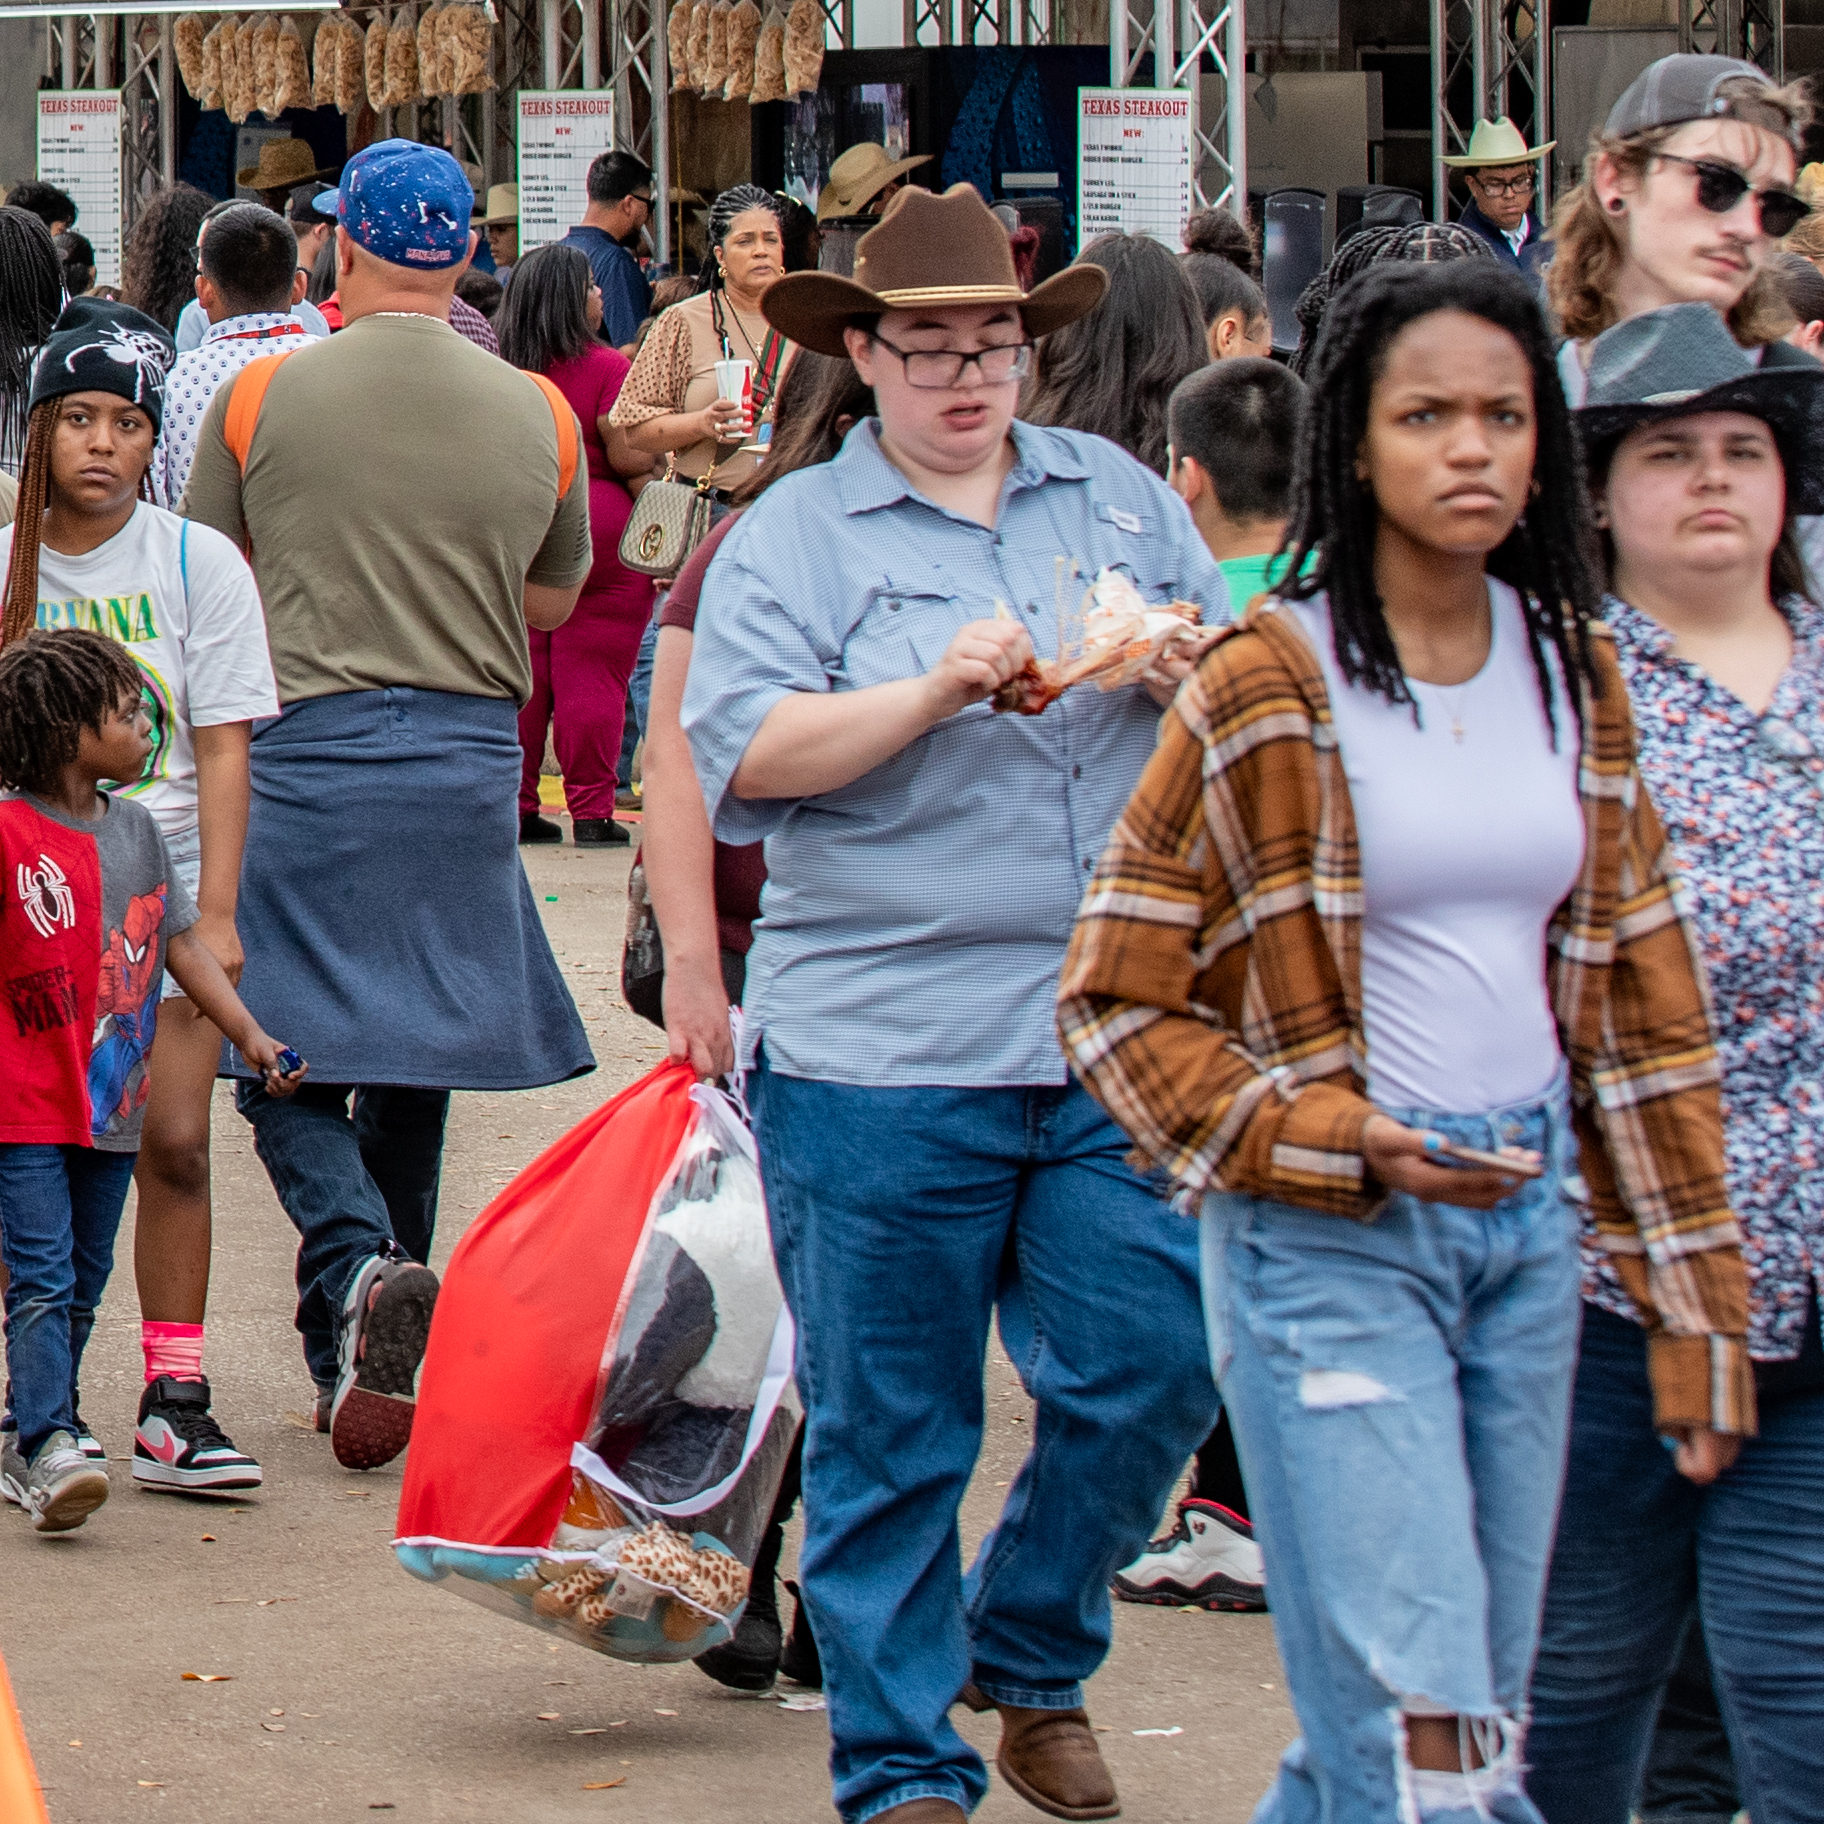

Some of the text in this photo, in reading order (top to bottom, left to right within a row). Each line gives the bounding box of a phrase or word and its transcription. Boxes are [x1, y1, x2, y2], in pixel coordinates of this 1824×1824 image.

[40, 99, 118, 113] TEXAS STEAKOUT
[521, 100, 611, 115] TEXAS STEAKOUT
[1083, 99, 1188, 115] TEXAS STEAKOUT
[1123, 128, 1145, 139] NEW:
[11, 982, 80, 1037] MAN
